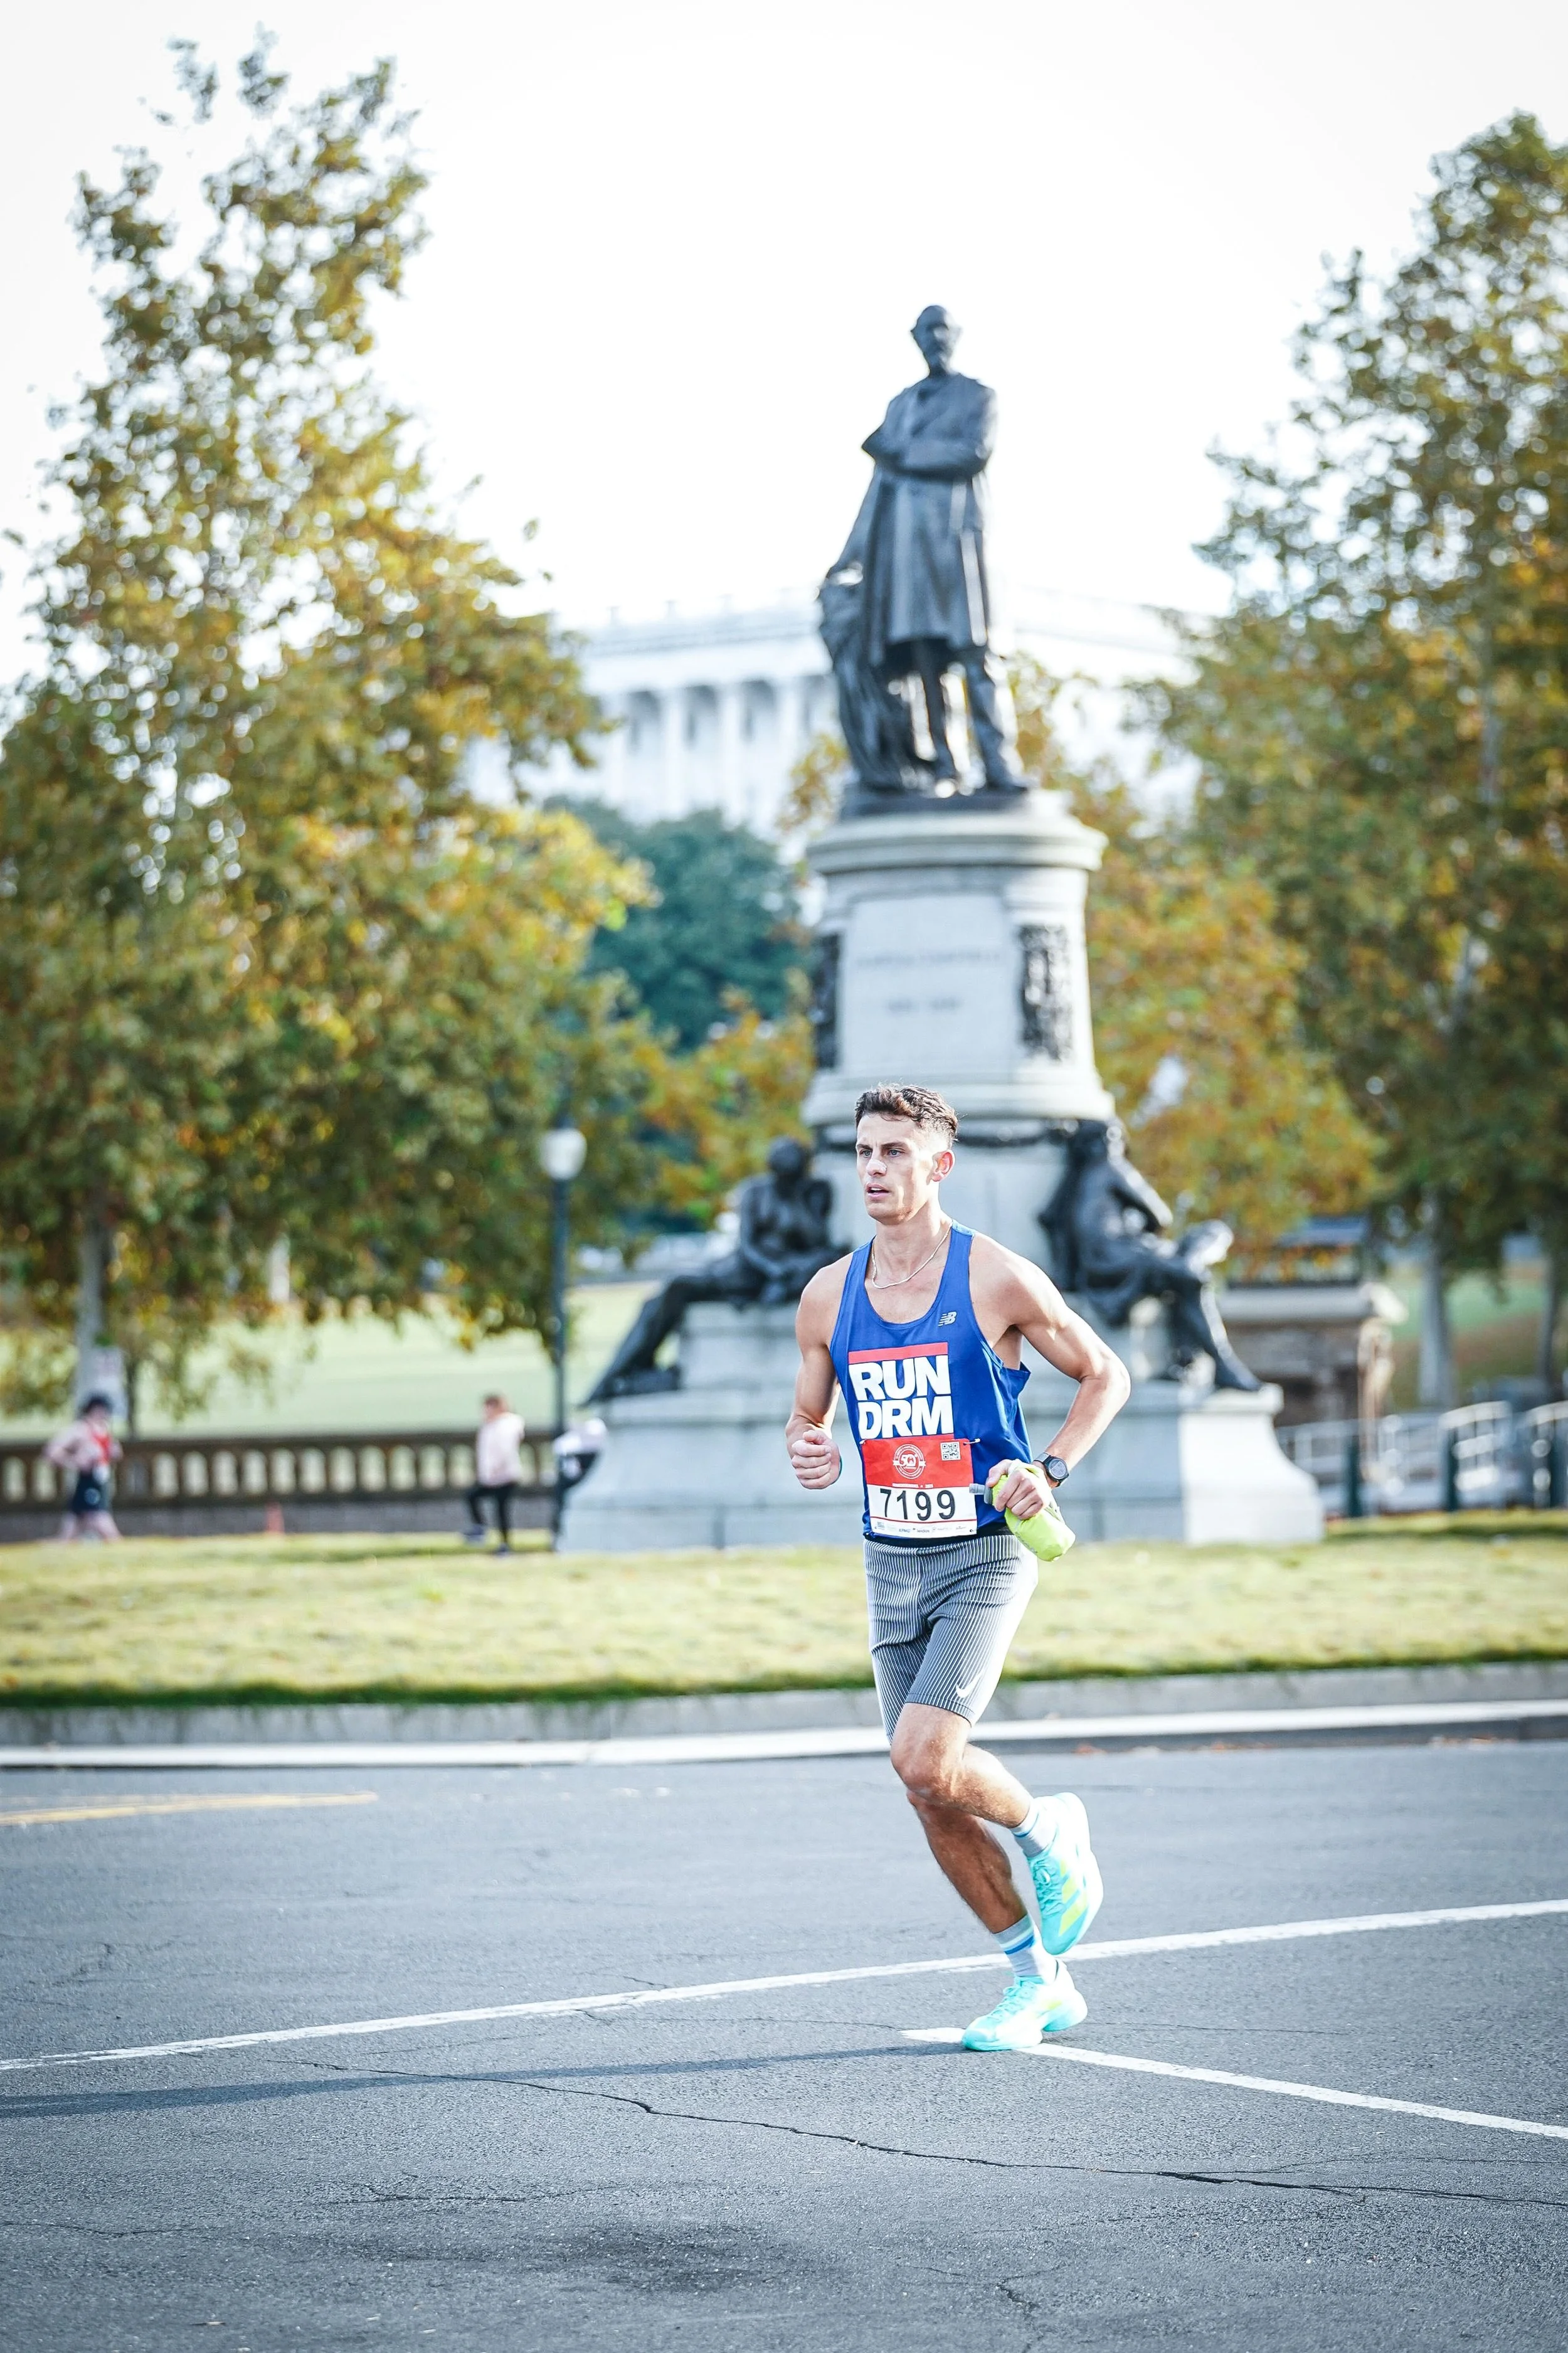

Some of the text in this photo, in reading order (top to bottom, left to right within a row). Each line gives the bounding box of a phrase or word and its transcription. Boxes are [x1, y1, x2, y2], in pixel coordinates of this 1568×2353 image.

[849, 1355, 951, 1401] RUN
[858, 1396, 954, 1439] DRM
[880, 1488, 955, 1521] 7199
